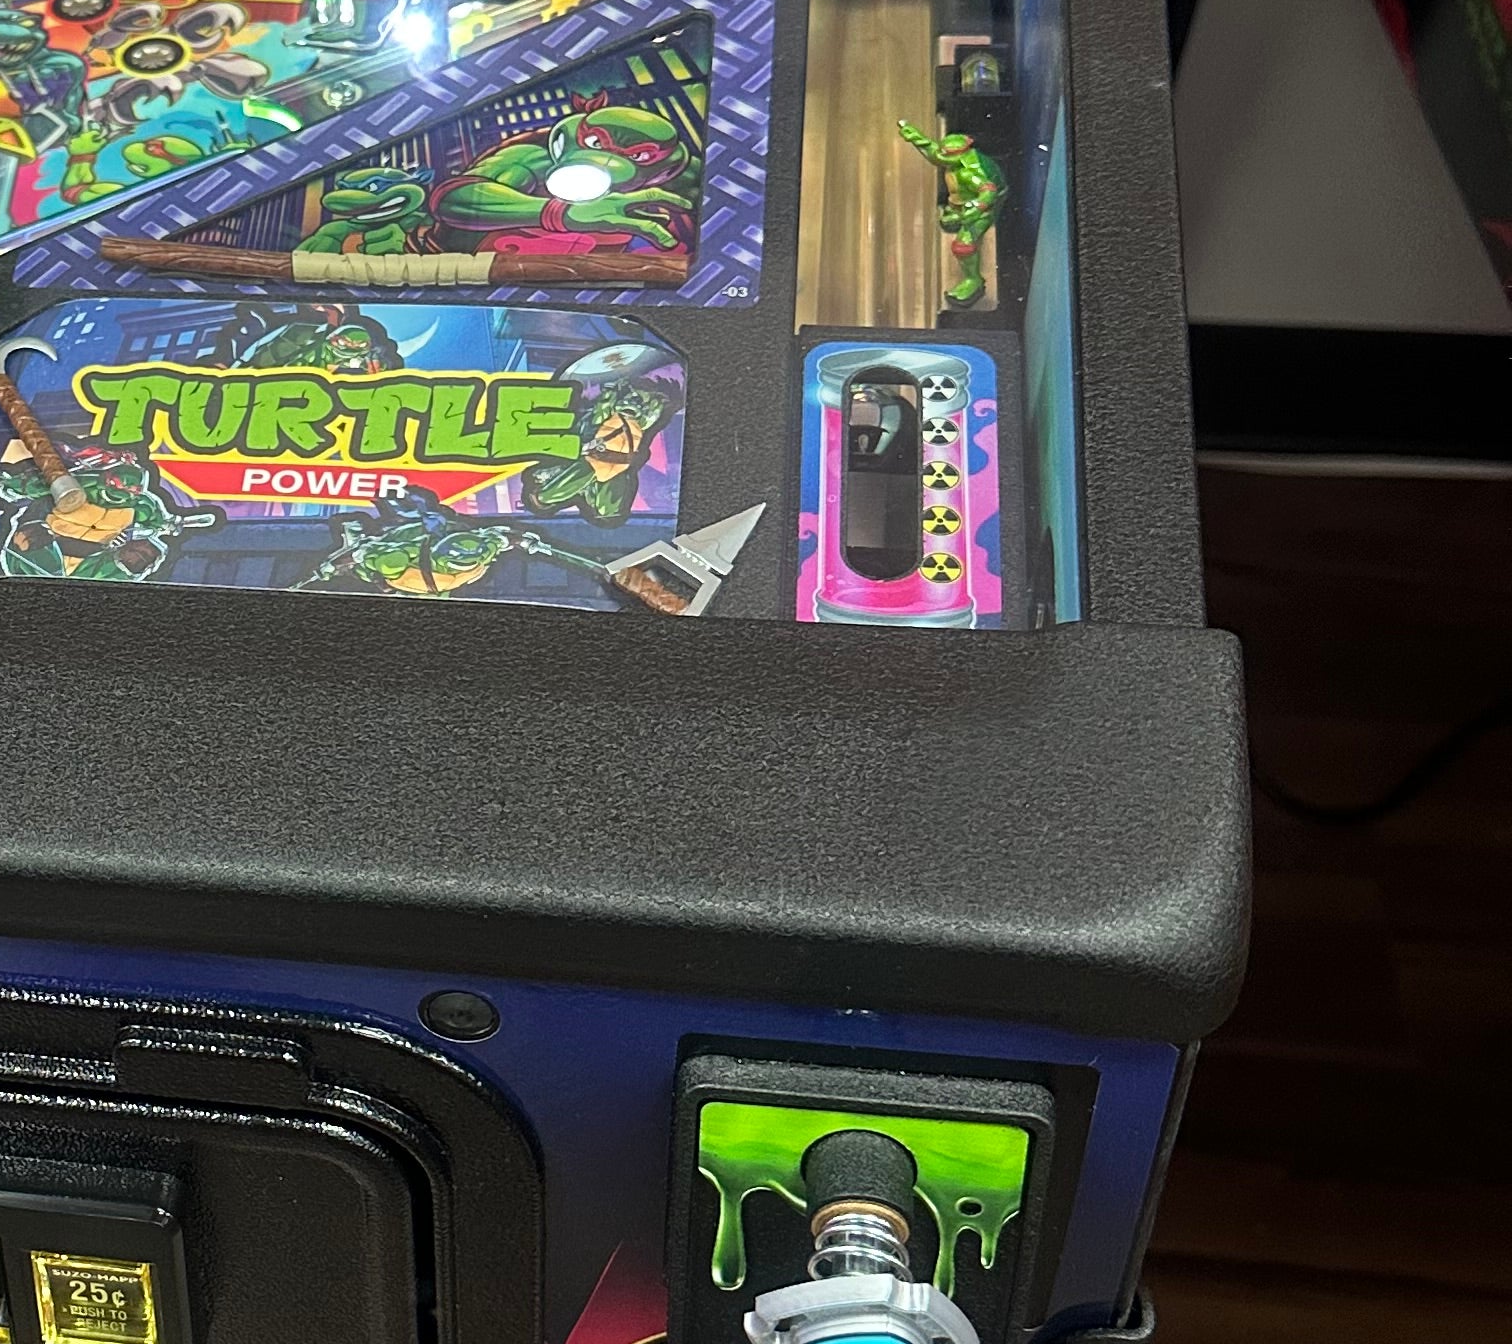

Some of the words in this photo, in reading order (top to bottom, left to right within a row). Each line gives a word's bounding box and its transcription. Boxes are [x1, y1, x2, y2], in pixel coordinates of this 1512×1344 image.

[721, 286, 748, 297] -03
[87, 374, 584, 462] TURTLE
[242, 468, 409, 500] POWER
[69, 1280, 126, 1308] 25¢
[70, 1305, 105, 1317] PUSH
[109, 1309, 128, 1320] TO
